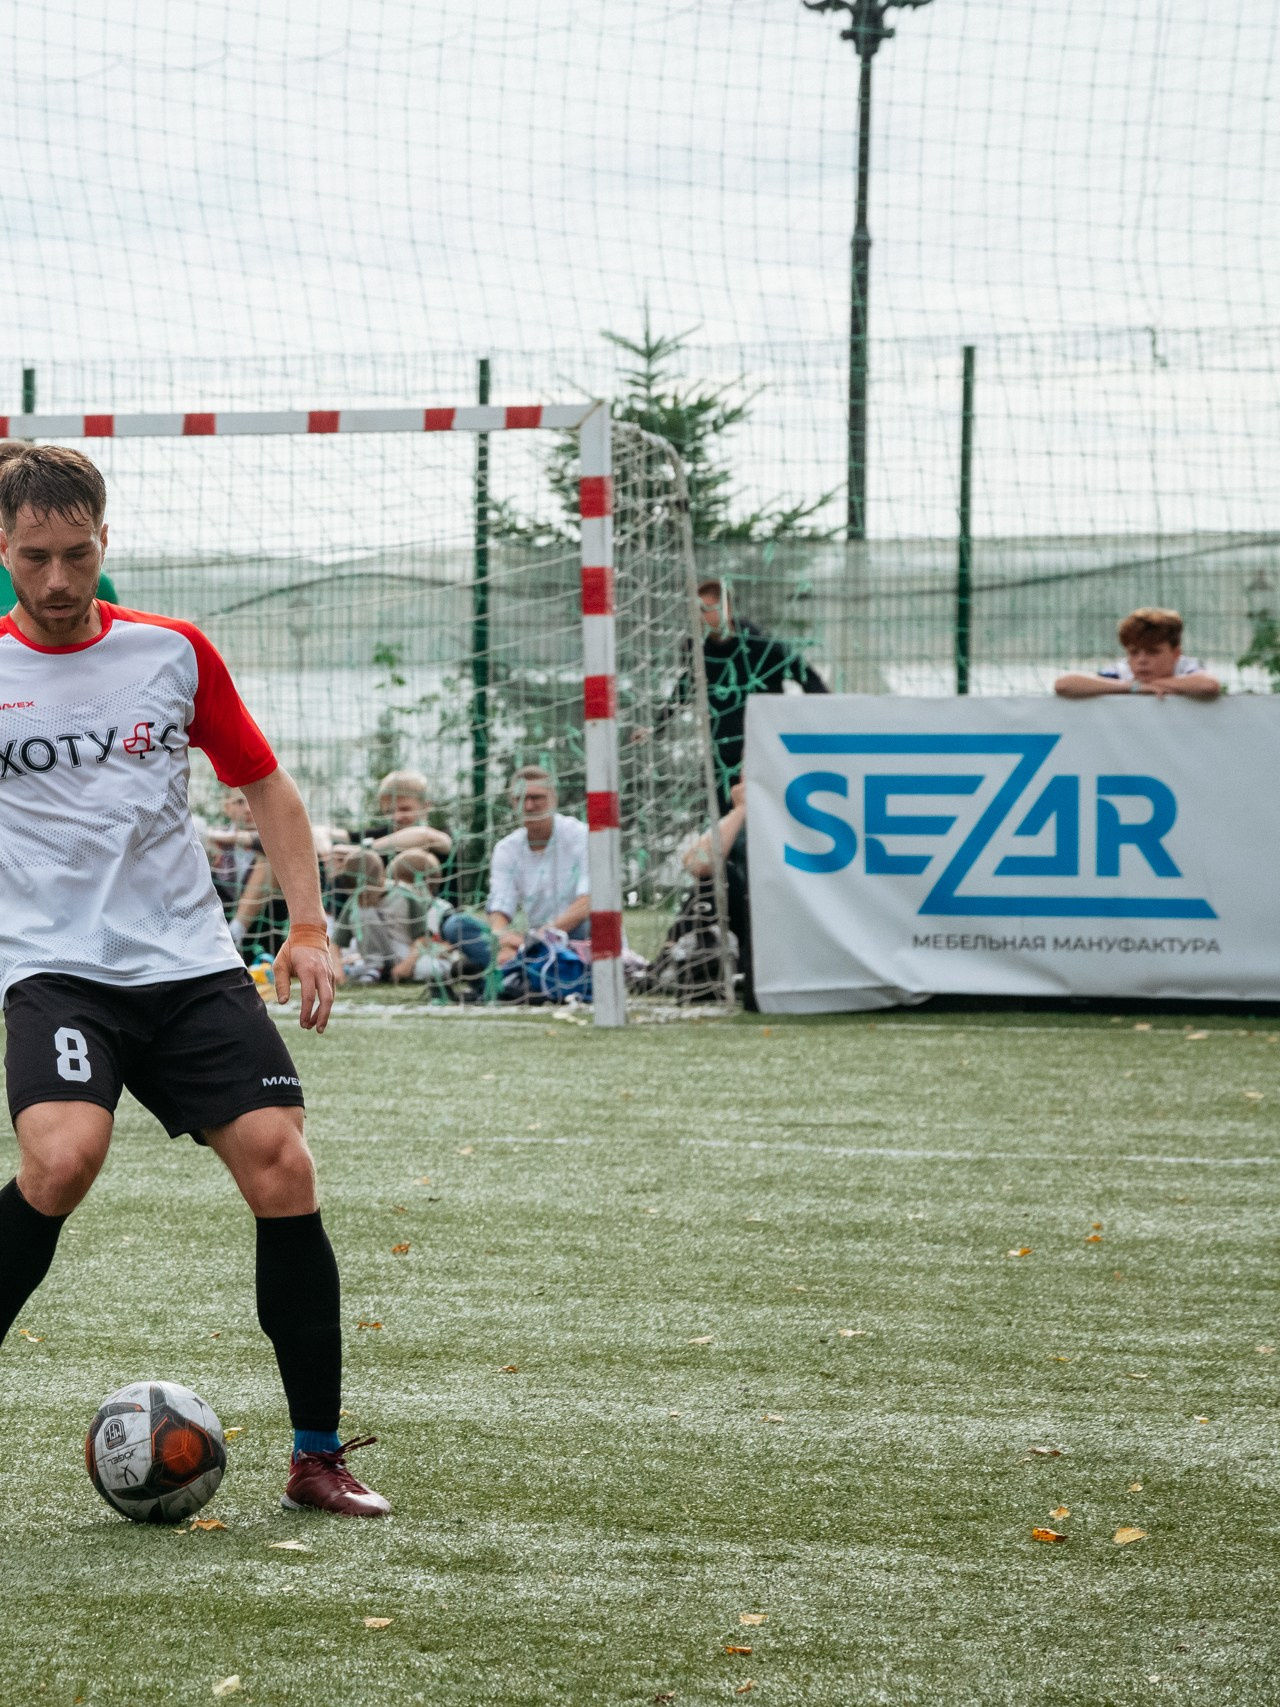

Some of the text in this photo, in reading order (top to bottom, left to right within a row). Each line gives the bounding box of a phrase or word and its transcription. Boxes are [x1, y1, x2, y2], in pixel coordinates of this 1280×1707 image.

[778, 734, 1218, 918] SEZAR
[912, 933, 1220, 954] МЕБЕЛЬНАЯ МАНУФАКТУРА
[54, 1027, 92, 1082] 8
